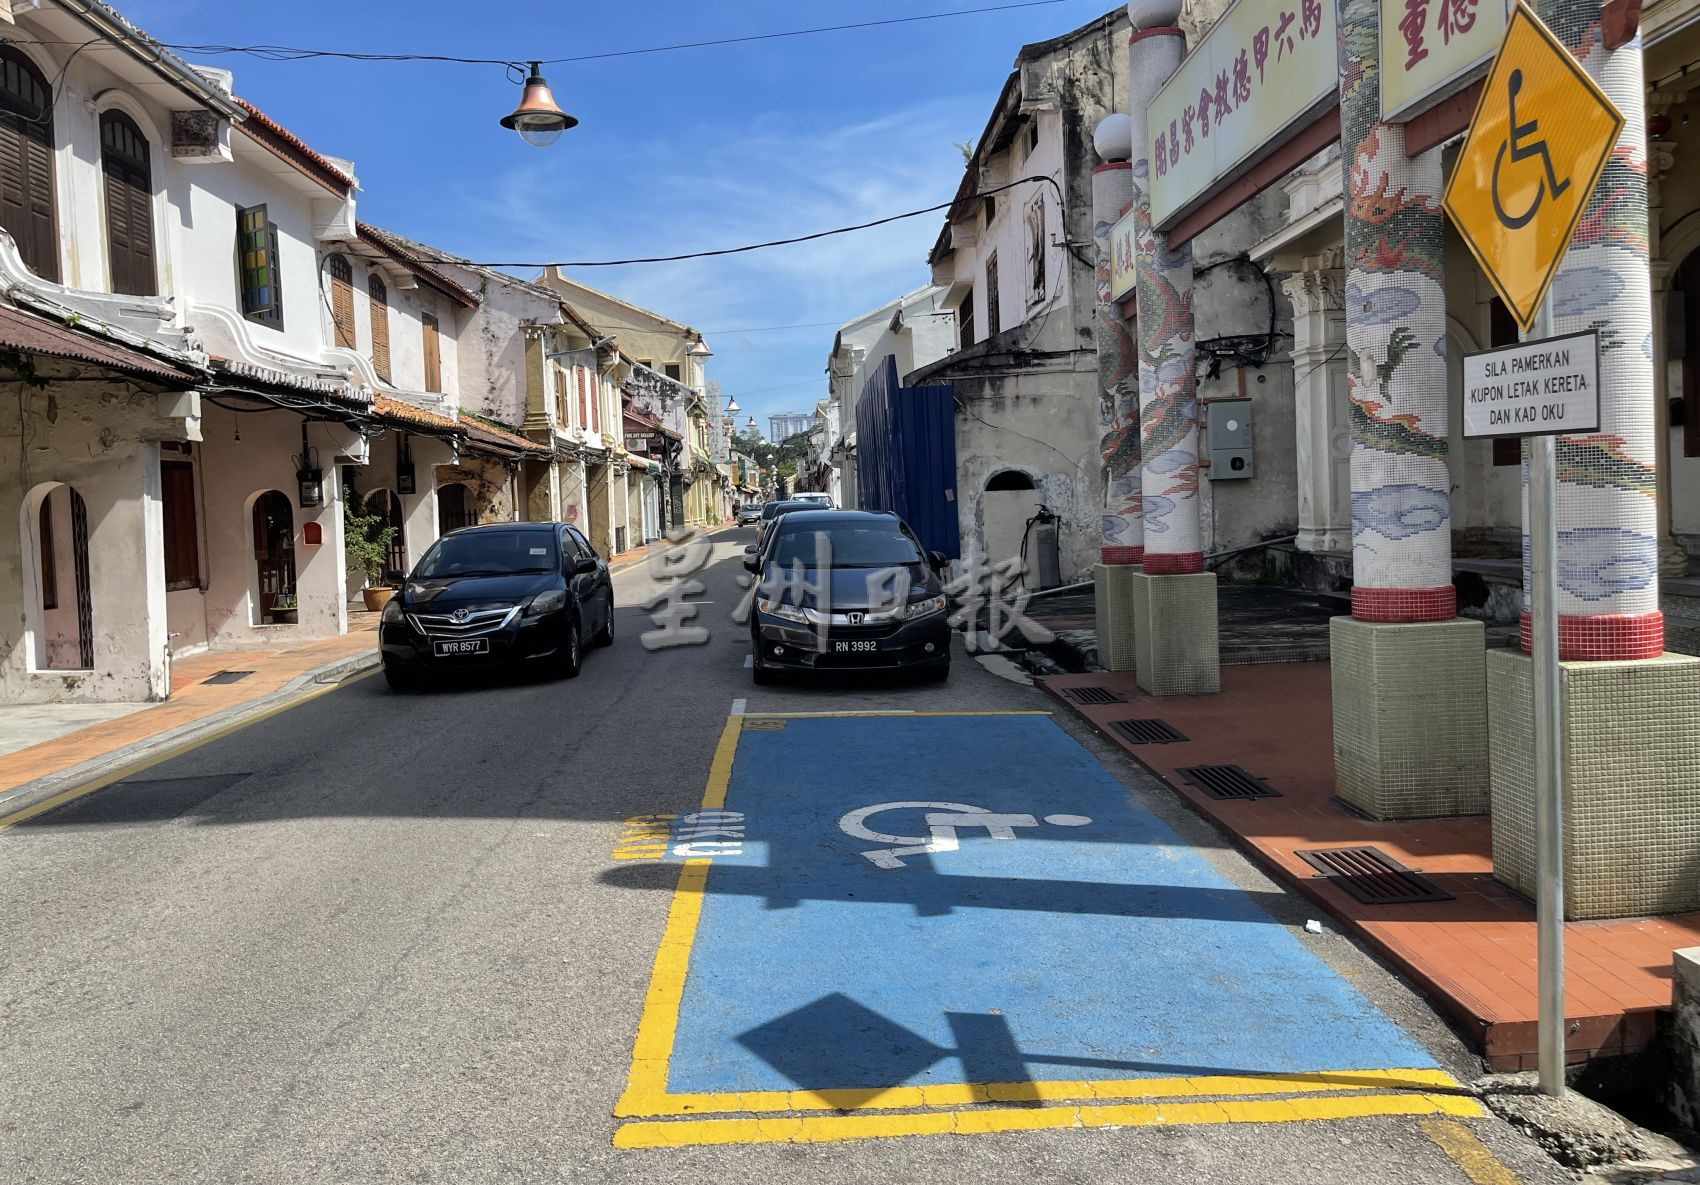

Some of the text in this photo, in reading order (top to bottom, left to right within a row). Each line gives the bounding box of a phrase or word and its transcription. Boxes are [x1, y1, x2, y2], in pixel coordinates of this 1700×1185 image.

[1485, 350, 1570, 378] SILA PAMERKAN
[1471, 374, 1587, 403] KUPON LETAK KERETA
[1490, 404, 1564, 425] DAN KAD OKU
[442, 641, 481, 653] WYR 8577
[835, 641, 877, 652] RN 3992
